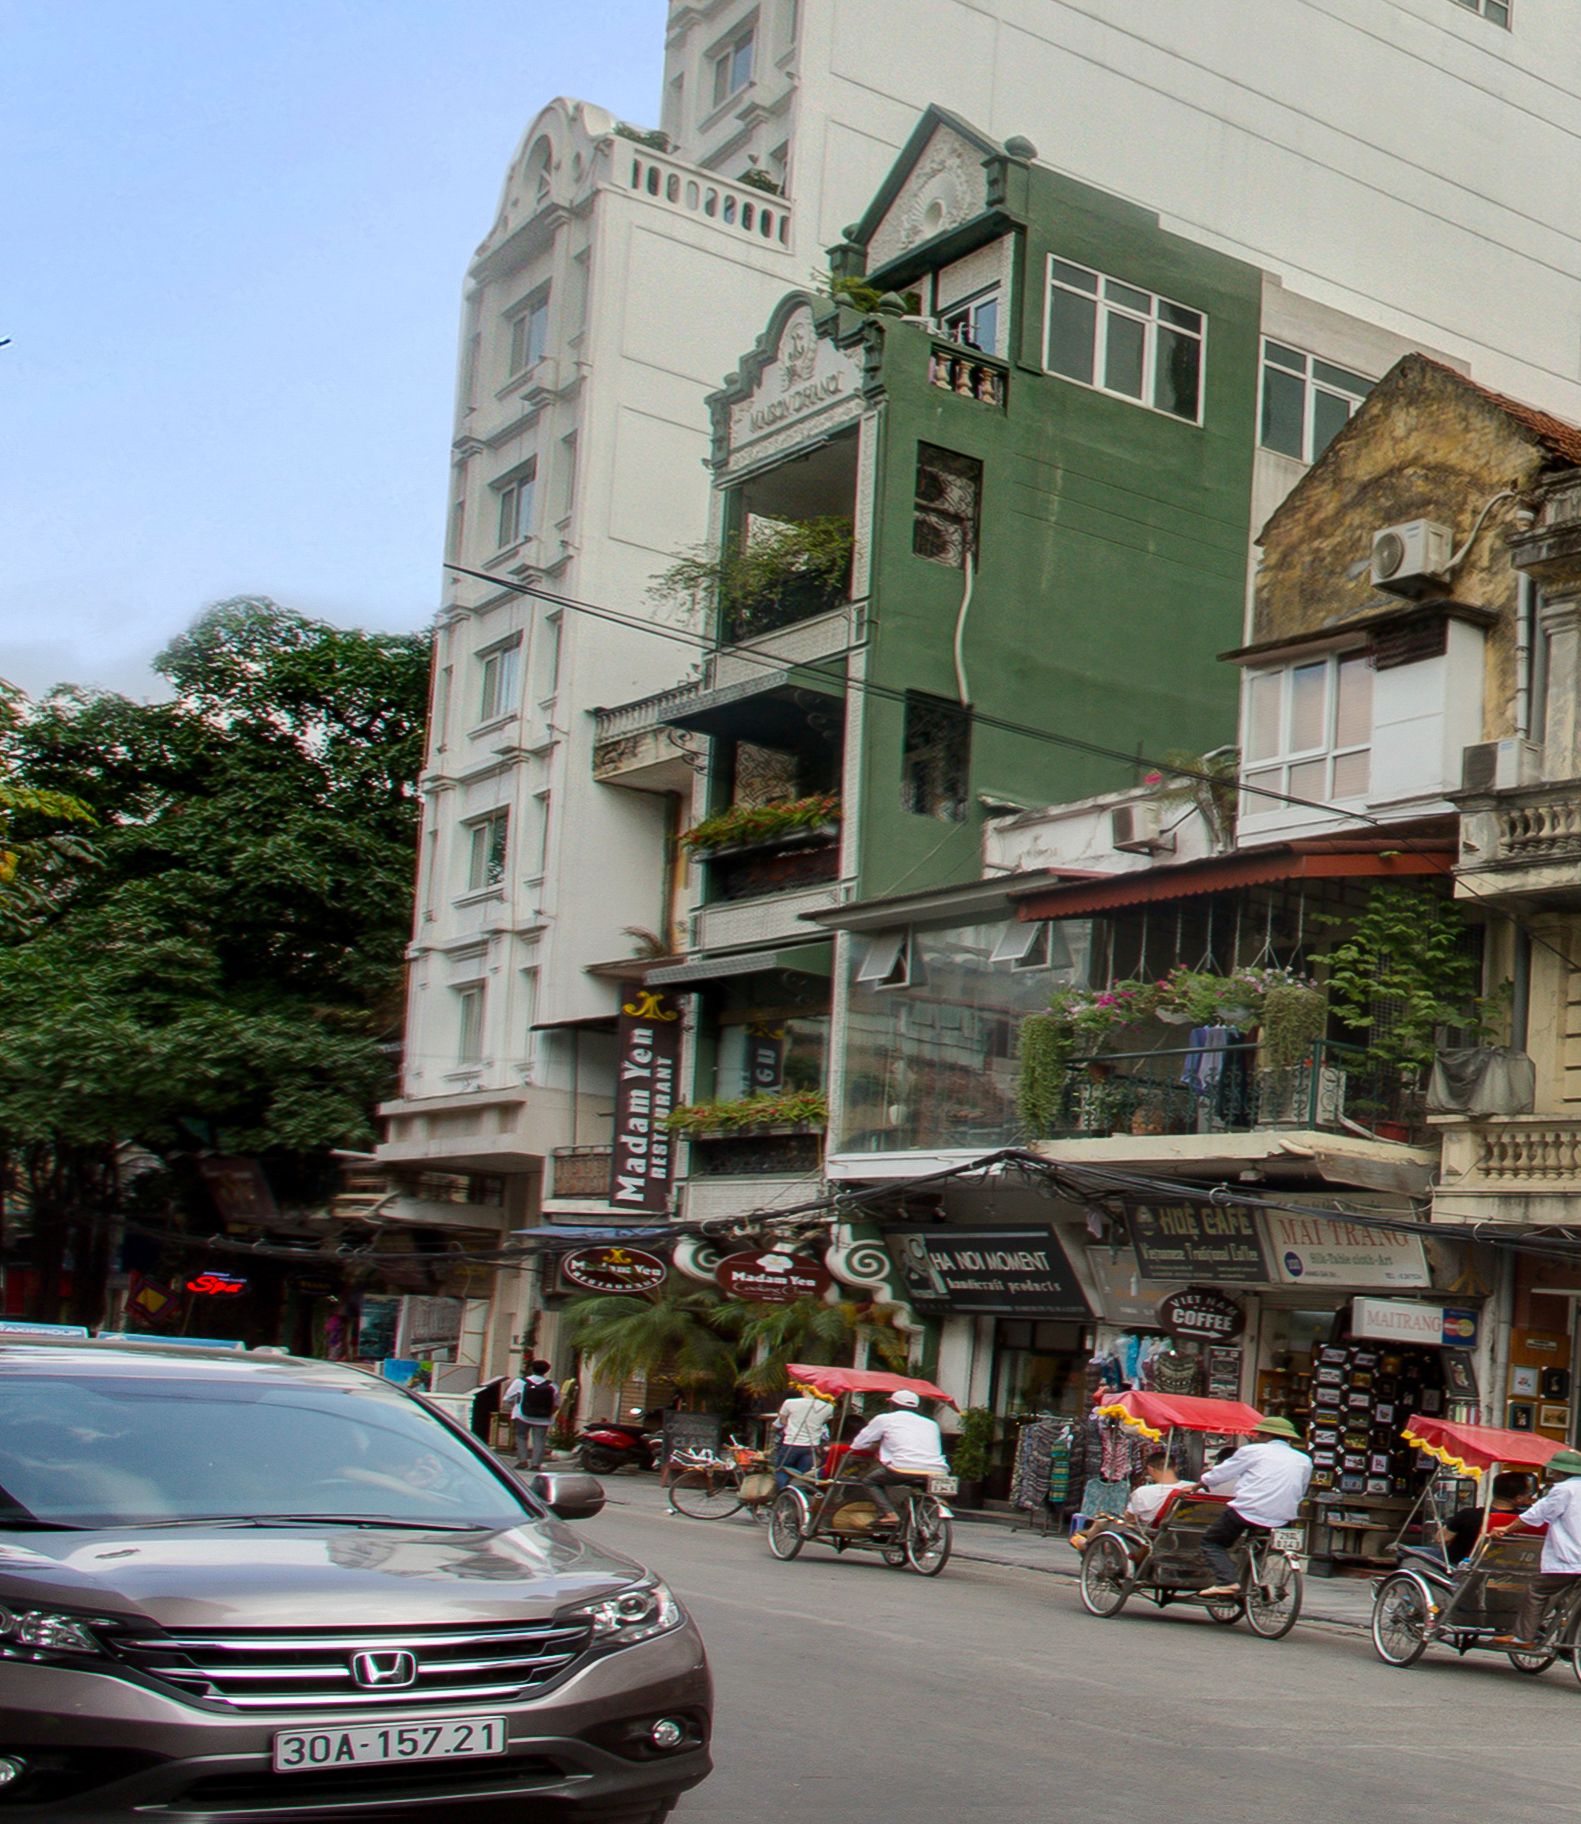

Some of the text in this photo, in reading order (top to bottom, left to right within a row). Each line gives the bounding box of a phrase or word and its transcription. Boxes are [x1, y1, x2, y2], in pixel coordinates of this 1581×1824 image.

[614, 1026, 654, 1203] Madam Yen
[650, 1055, 673, 1180] RESTAURANT
[1201, 1207, 1255, 1235] CAFE
[1277, 1218, 1411, 1247] MAI TRANG
[928, 1251, 1051, 1271] HA NOI MOMENT
[187, 1275, 243, 1295] Spa
[731, 1270, 817, 1287] Madam Yen
[1169, 1295, 1202, 1308] VIET
[1172, 1308, 1233, 1331] COFFEE
[282, 1722, 495, 1766] 30A-157.21
